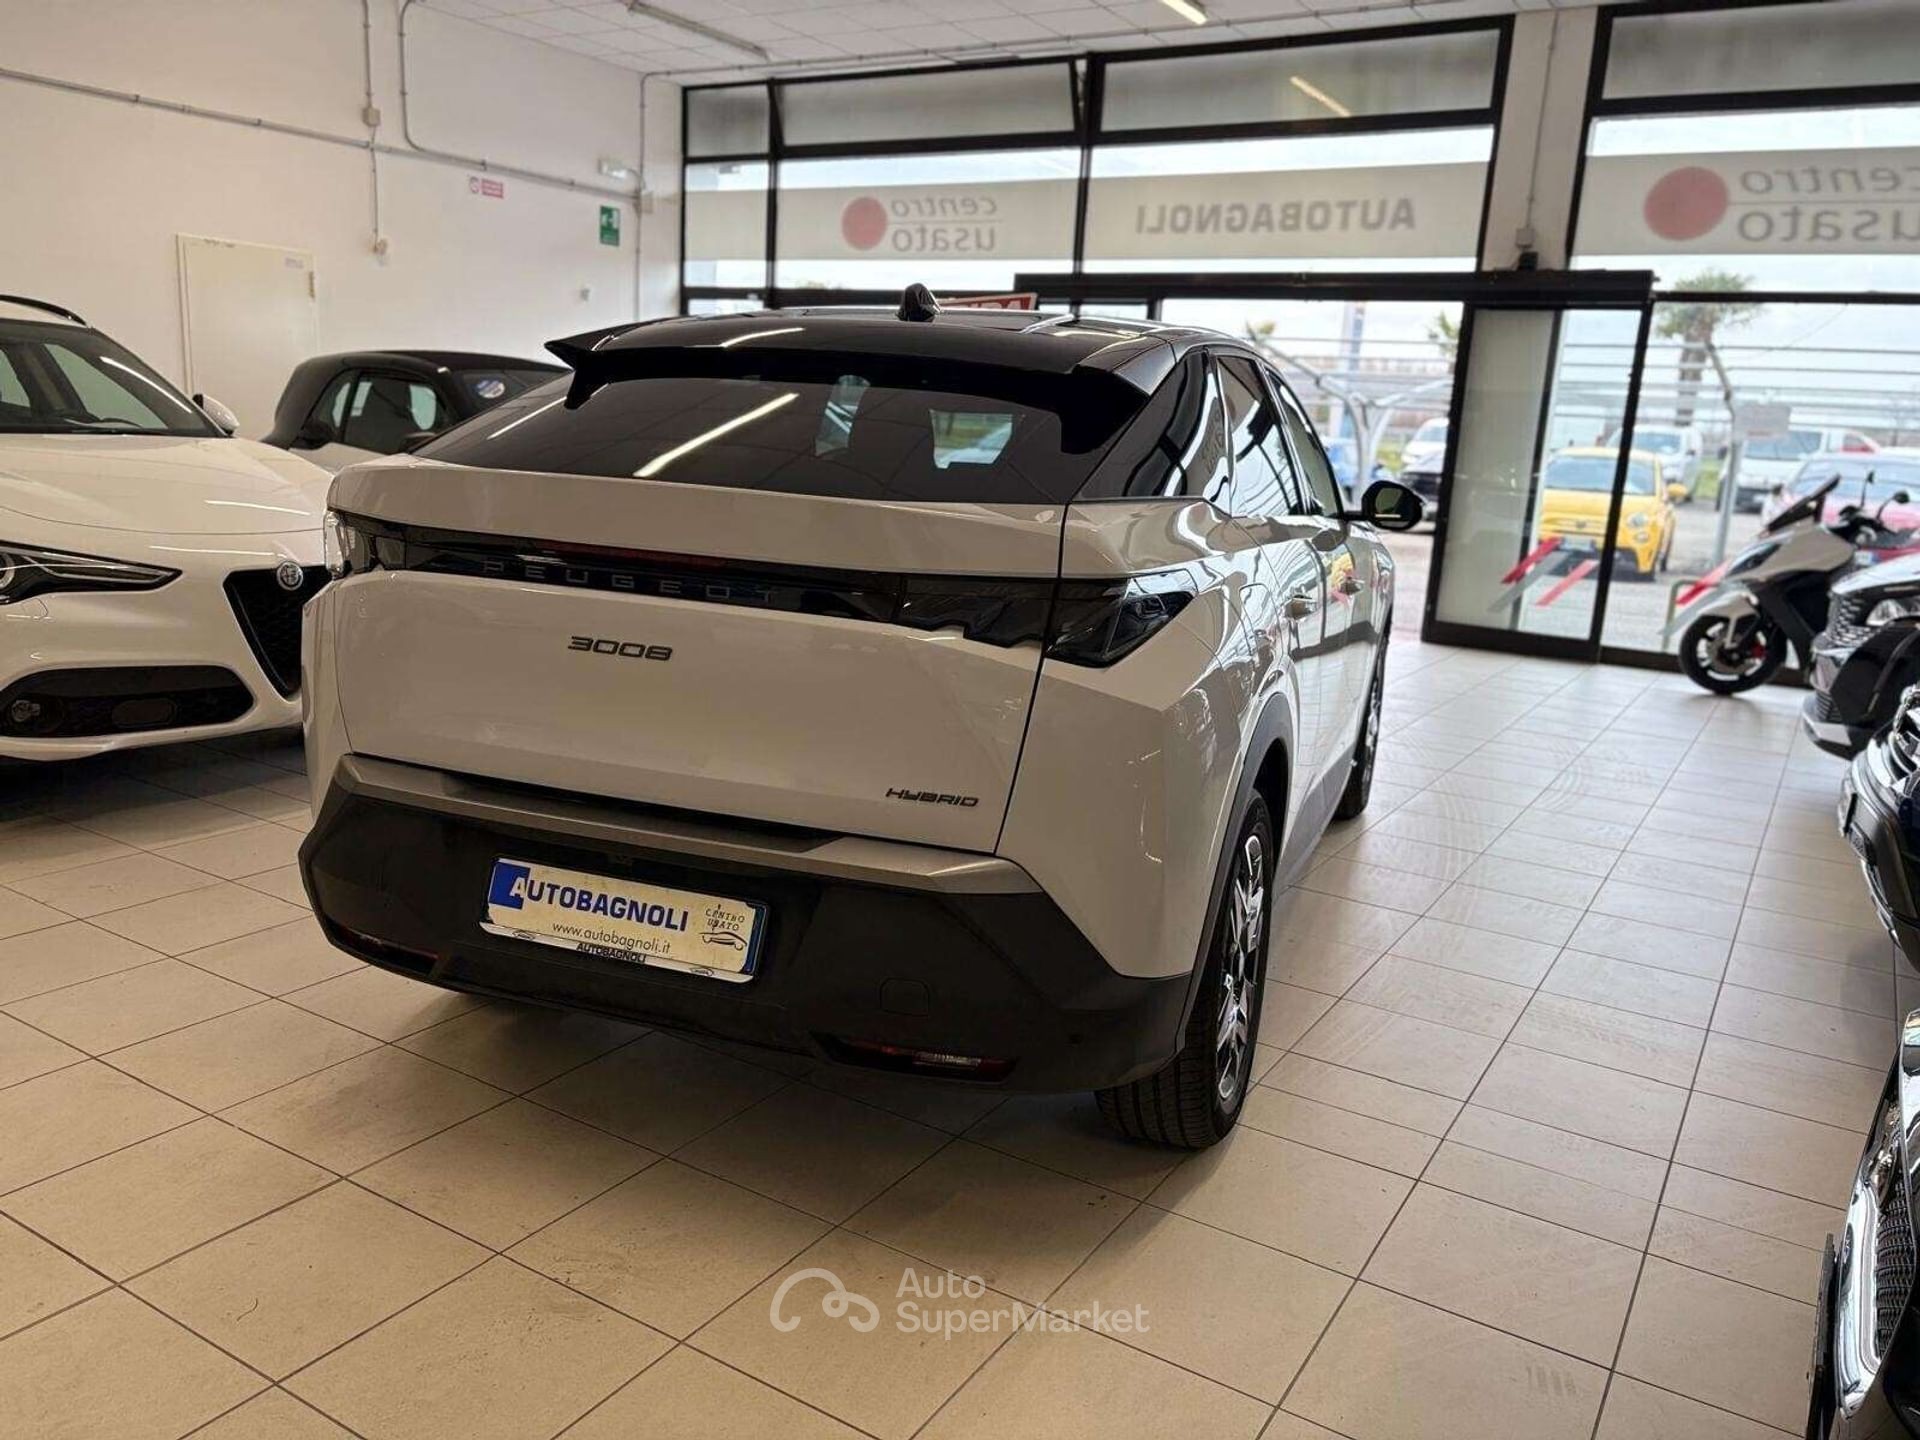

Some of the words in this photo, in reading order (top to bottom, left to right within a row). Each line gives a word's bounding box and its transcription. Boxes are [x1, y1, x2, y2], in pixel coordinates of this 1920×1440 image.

[482, 560, 776, 602] PEUGEOT
[567, 636, 673, 661] 3008
[885, 788, 979, 807] HYBRID
[509, 876, 689, 932] AUTOBAGNOLI
[552, 922, 671, 954] www.autobagnoli.it
[576, 942, 648, 964] AUTOBAGNOLI
